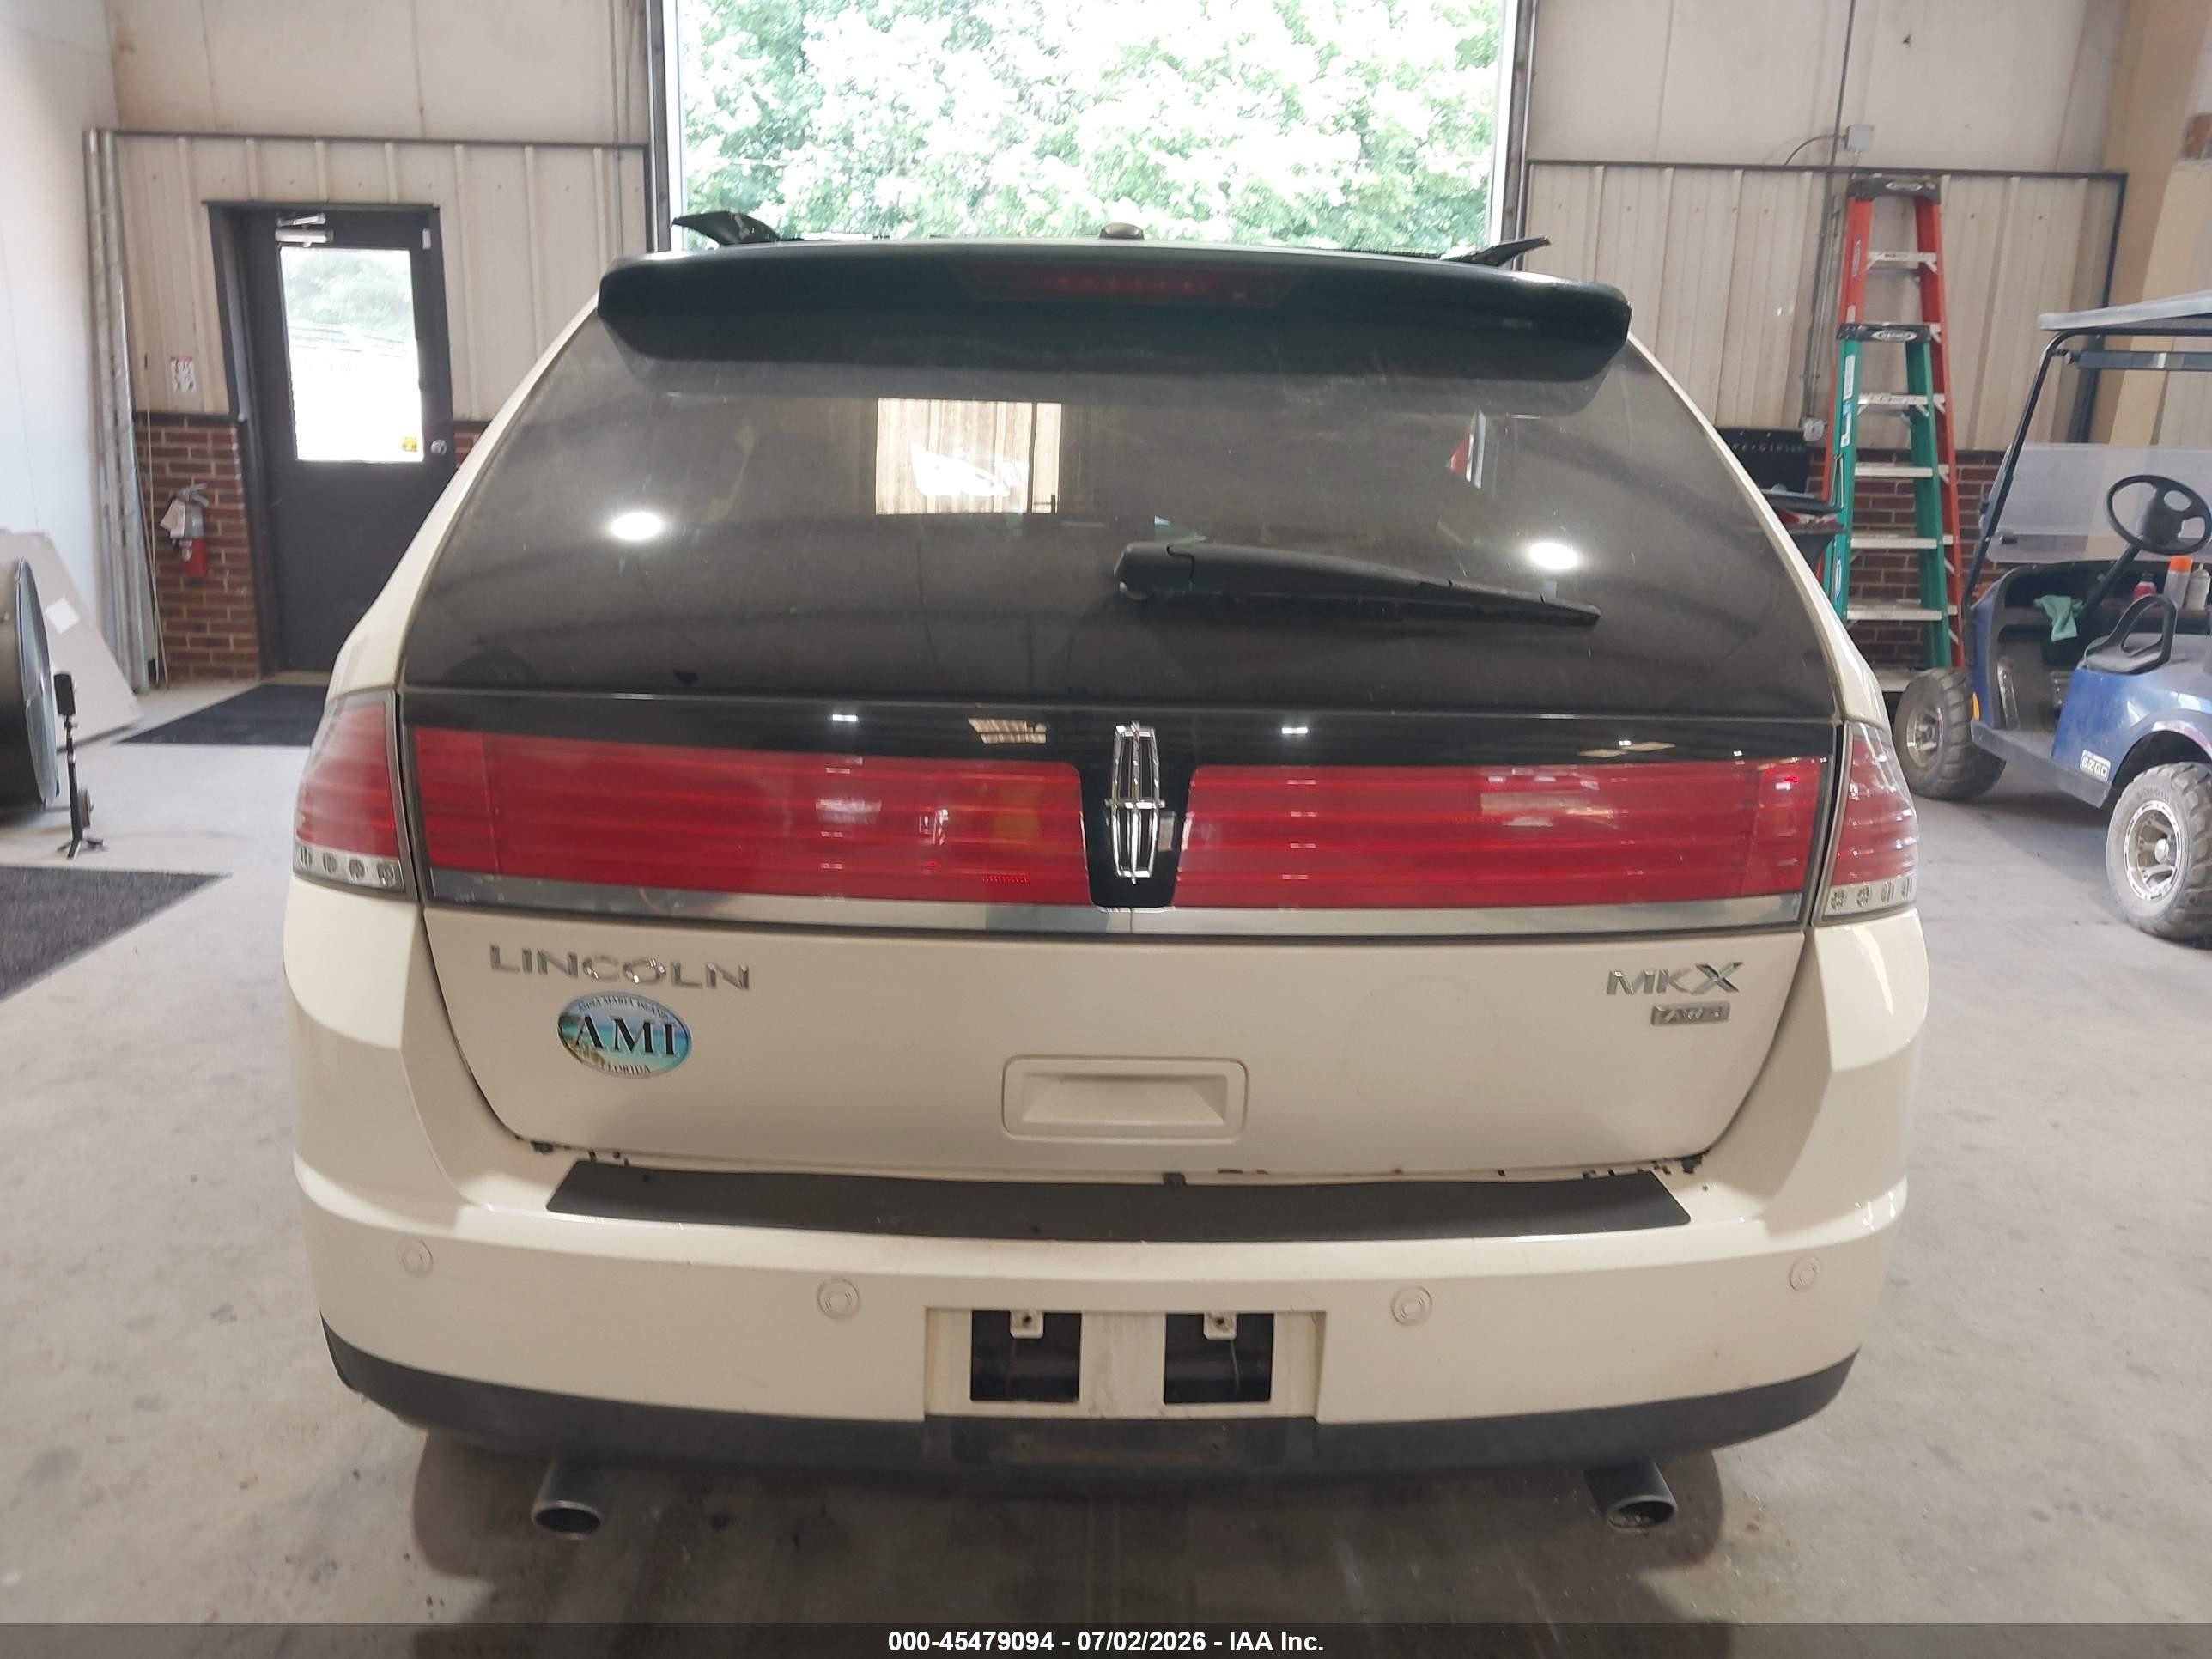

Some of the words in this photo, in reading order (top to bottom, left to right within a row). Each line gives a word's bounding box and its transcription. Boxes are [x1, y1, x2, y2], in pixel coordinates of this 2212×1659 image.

[489, 944, 750, 990] LINCOLN
[1607, 962, 1744, 995] MKX
[574, 1015, 680, 1056] AMI
[600, 1063, 652, 1076] FLORIDA
